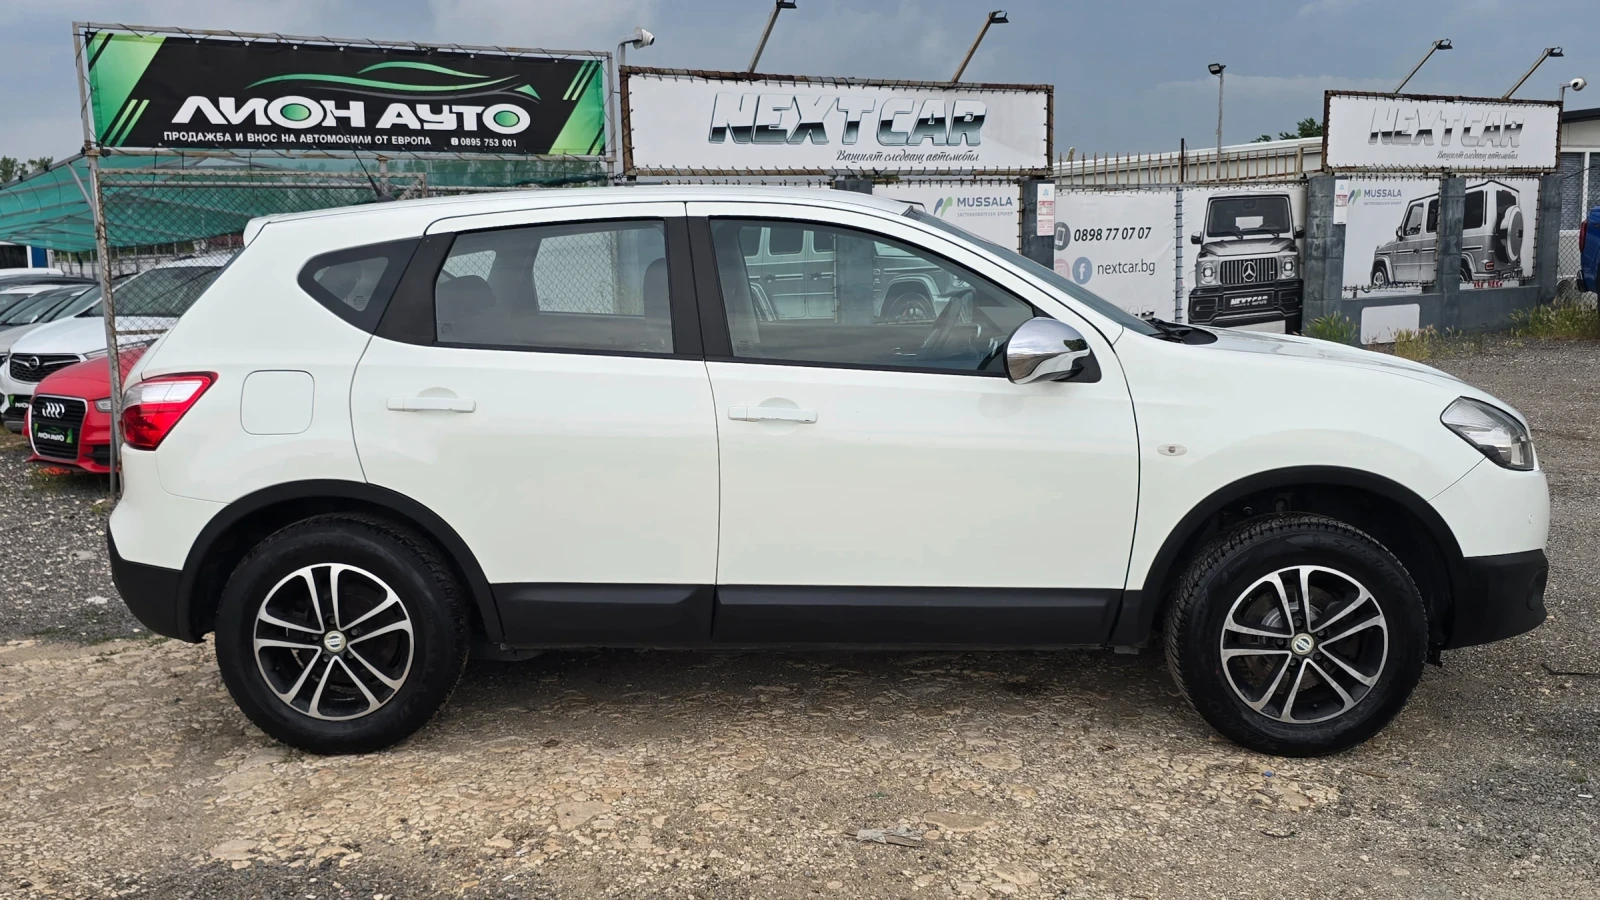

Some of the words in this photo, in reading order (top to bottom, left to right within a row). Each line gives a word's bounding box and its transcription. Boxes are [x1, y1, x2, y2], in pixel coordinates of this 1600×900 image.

[171, 95, 366, 129] ЛИОН
[375, 102, 531, 135] АУТО
[163, 131, 232, 142] ПРОДАЖБА
[235, 132, 244, 142] И
[246, 132, 278, 143] ВНОС
[281, 133, 297, 143] НА
[299, 134, 372, 144] АВТОМОБИЛИ
[374, 135, 389, 144] ОТ
[391, 135, 432, 145] ЕВРОПА
[460, 137, 481, 146] 0895
[484, 138, 499, 147] 753
[501, 139, 517, 147] 001
[925, 149, 979, 162] автомобил
[1363, 188, 1402, 198] MUSSALA
[956, 196, 1013, 208] MUSSALA
[1073, 227, 1103, 242] 0898
[1105, 227, 1120, 241] 77
[1121, 226, 1136, 240] 07
[1137, 226, 1152, 240] 07
[1097, 258, 1156, 276] nextcar.bg
